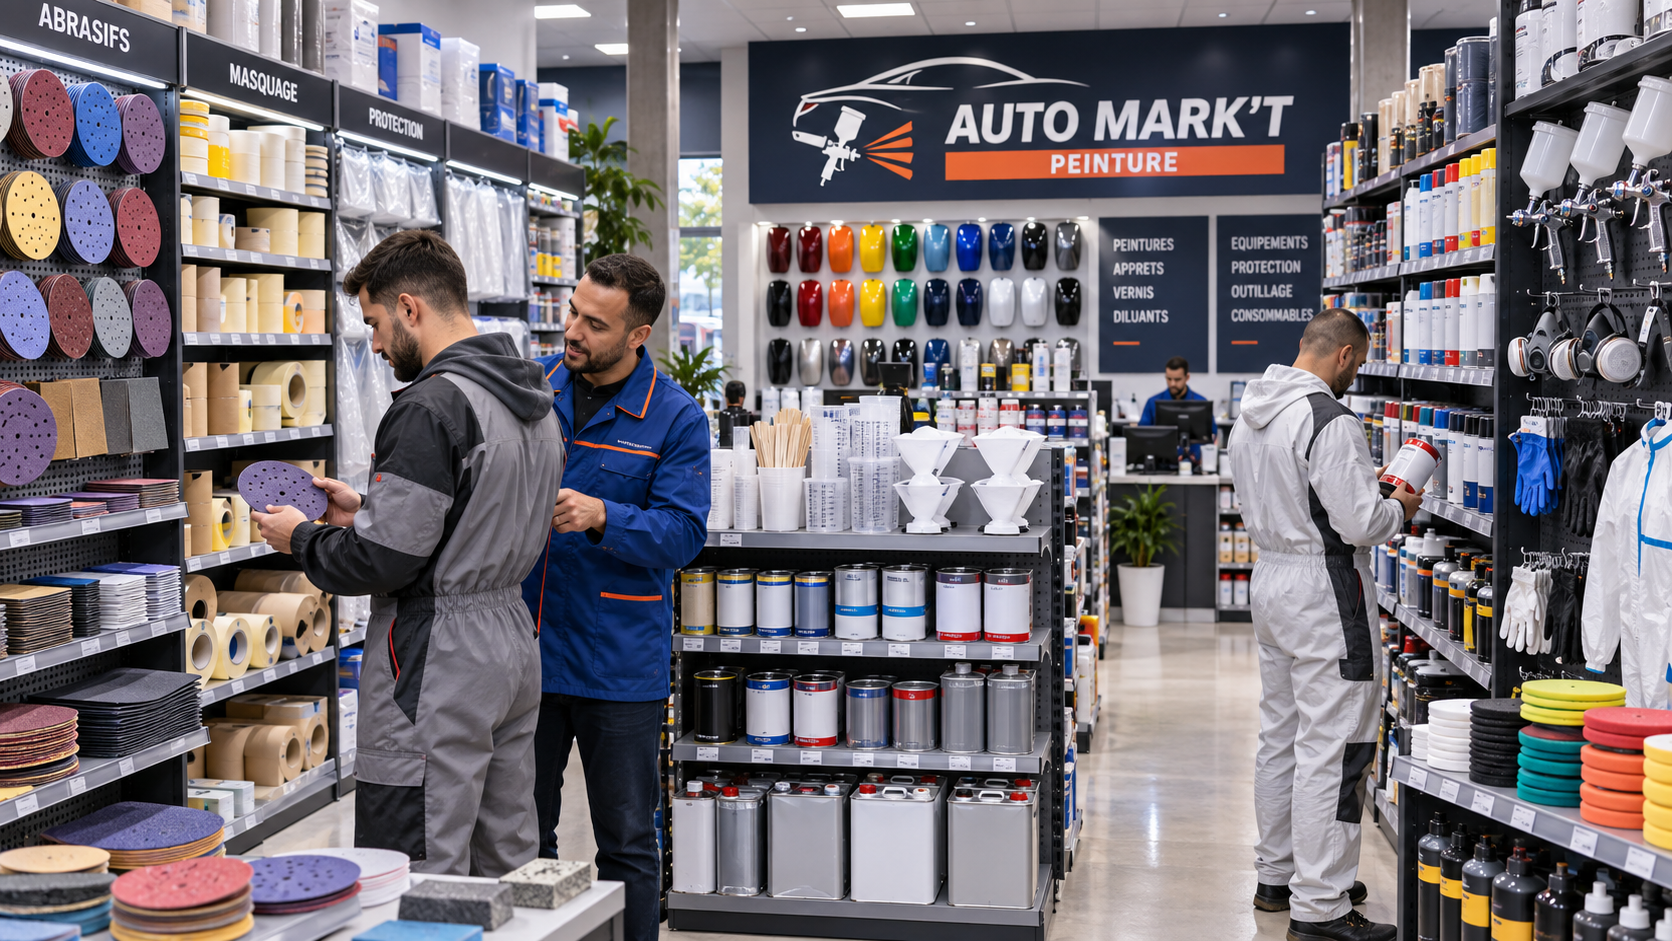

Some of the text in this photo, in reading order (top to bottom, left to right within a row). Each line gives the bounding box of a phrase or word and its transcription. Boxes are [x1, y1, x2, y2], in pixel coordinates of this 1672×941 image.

[39, 2, 130, 53] ABRASIFS
[229, 62, 298, 104] MASQUAGE
[369, 107, 423, 141] PROTECTION
[944, 95, 1294, 145] AUTO MARK'T
[1050, 152, 1178, 174] PEINTURE
[1112, 237, 1174, 252] PEINTURES
[1231, 235, 1309, 251] EQUIPEMENTS
[1112, 261, 1164, 276] APPRETS
[1231, 260, 1301, 274] PROTECTION
[1112, 285, 1155, 299] VERNIS
[1231, 284, 1293, 298] OUTILLAGE
[1112, 309, 1169, 323] DILUANTS
[1231, 308, 1314, 322] CONSOMMABLES
